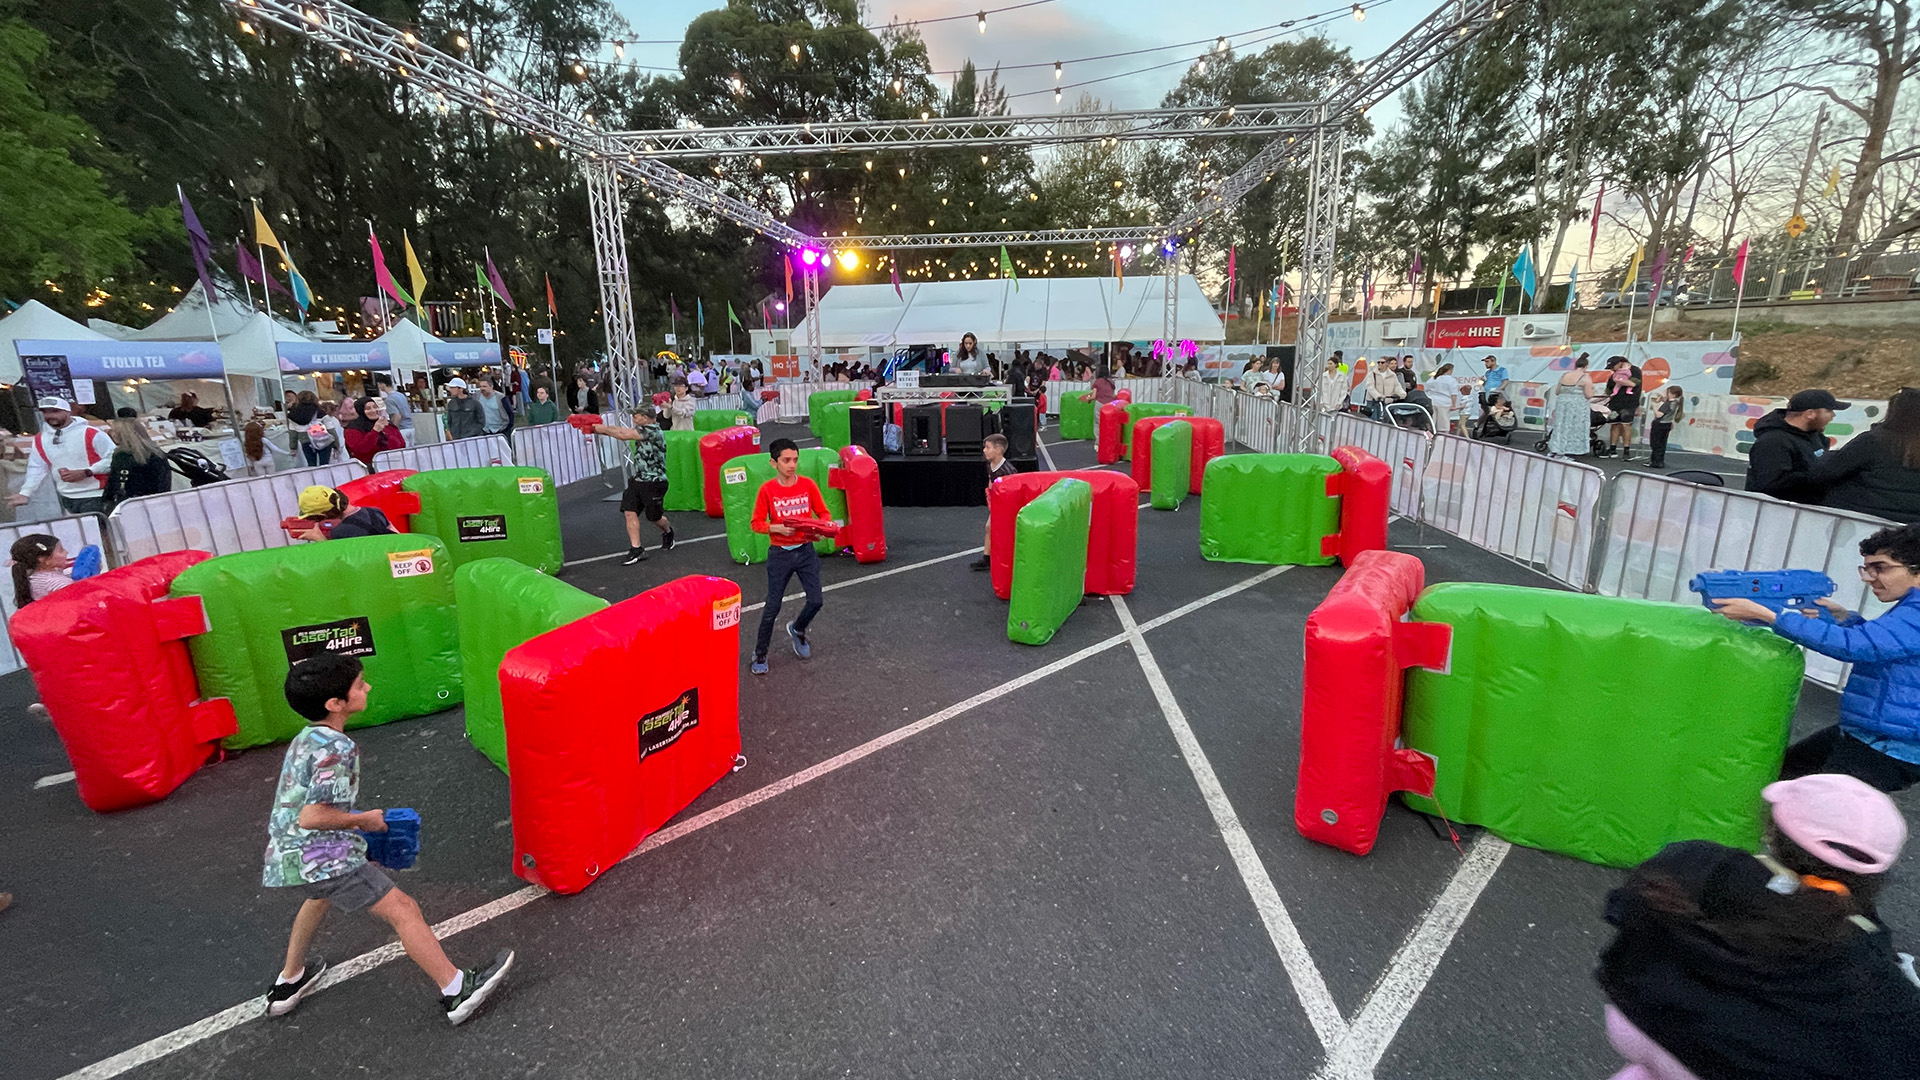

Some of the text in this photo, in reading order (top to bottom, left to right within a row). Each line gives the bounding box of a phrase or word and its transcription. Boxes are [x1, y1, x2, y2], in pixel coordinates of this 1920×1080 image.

[1468, 326, 1501, 338] HIRE
[102, 355, 166, 369] EVOLVA TEA
[773, 492, 809, 507] DOWN
[776, 506, 809, 517] TOWN
[716, 610, 732, 620] KEEP
[718, 618, 732, 626] OFF
[292, 626, 357, 646] LaserTag
[325, 635, 362, 650] 4Hire
